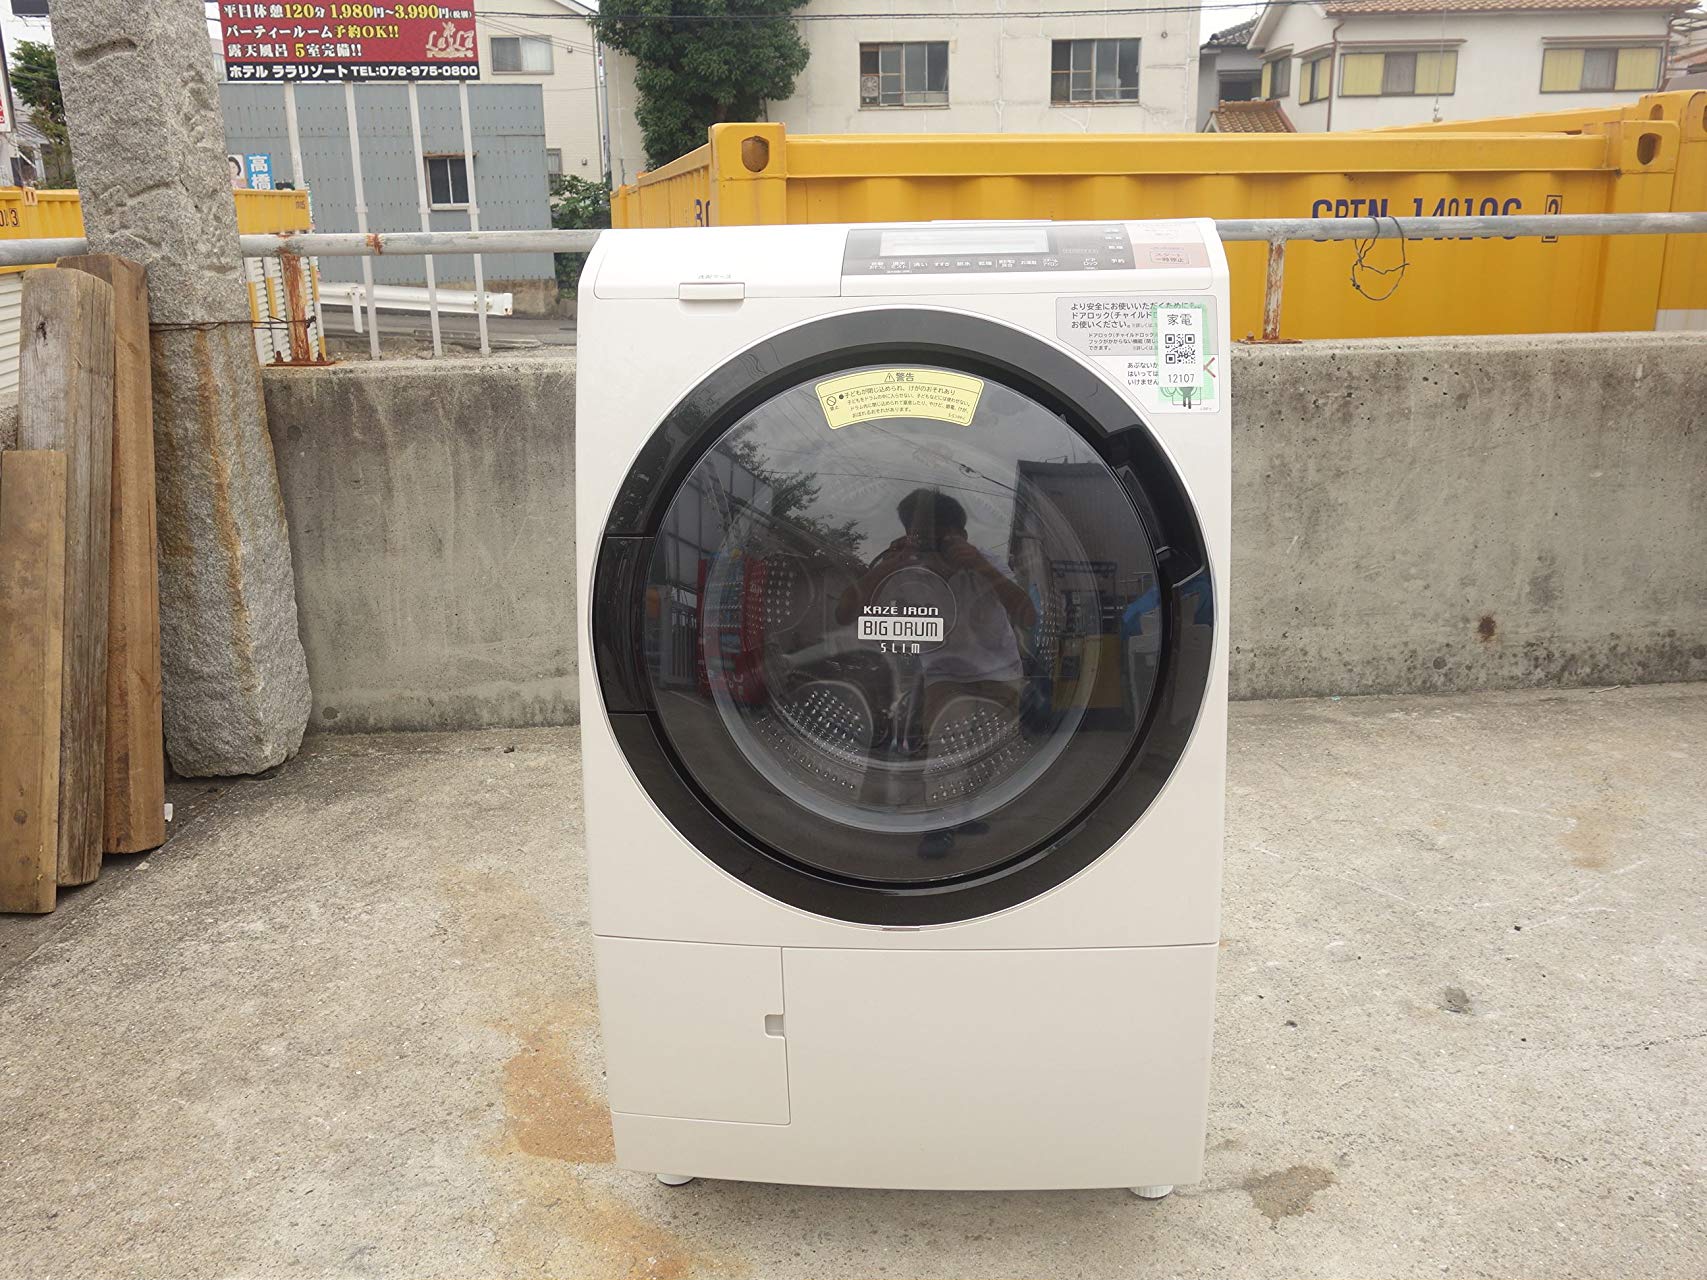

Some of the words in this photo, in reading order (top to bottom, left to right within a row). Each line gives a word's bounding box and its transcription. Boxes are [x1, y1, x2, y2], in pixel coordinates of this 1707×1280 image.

[228, 43, 288, 57] 露天風呂
[229, 65, 268, 78] ホテル
[272, 65, 348, 78] ララリゾート
[351, 65, 478, 76] TEL:078-975-0800
[1166, 313, 1193, 326] 家電
[896, 372, 914, 382] 警告
[1168, 373, 1195, 384] 12107
[863, 606, 898, 615] KAZE
[903, 607, 939, 616] IRON
[863, 620, 888, 636] BIG
[893, 621, 938, 637] DRUM
[880, 642, 920, 654] SLIM
